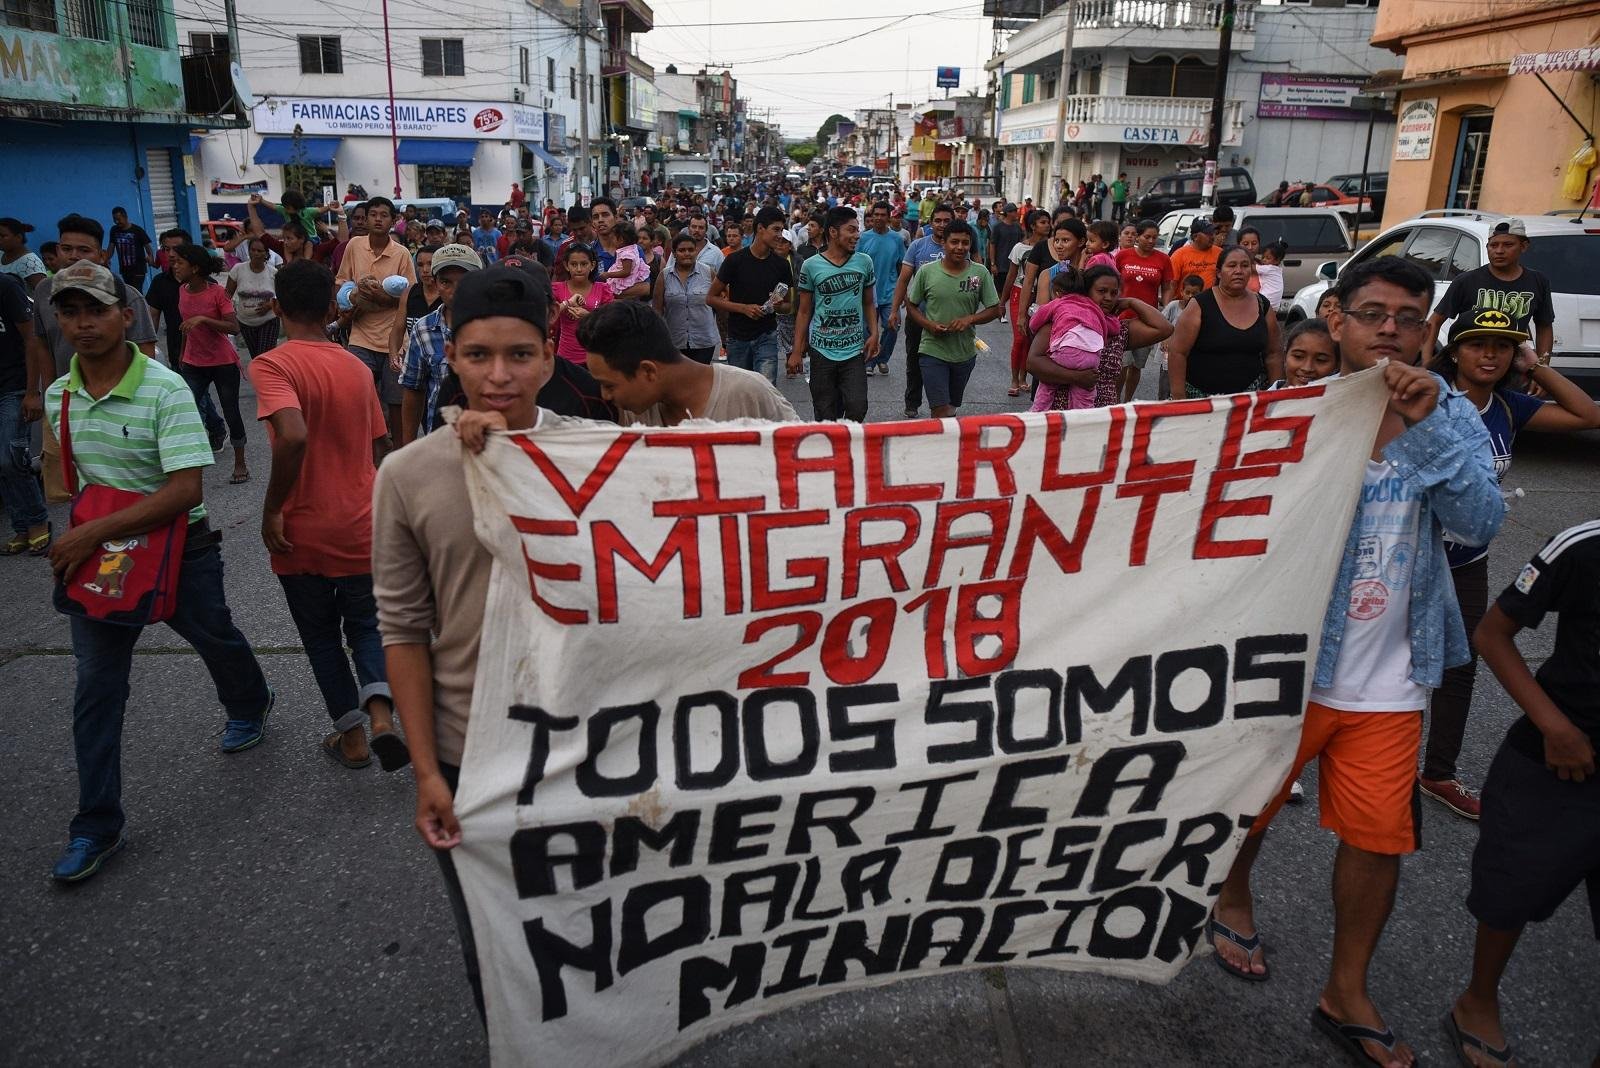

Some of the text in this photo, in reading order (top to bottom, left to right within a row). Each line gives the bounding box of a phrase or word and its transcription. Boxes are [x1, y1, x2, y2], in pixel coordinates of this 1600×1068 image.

[291, 103, 380, 120] FARMACIAS
[384, 105, 467, 123] SIMILARES
[365, 122, 384, 130] PERO
[386, 123, 402, 131] MS
[1123, 127, 1179, 142] CASETA
[1126, 157, 1159, 168] NOVIAS
[1476, 288, 1534, 319] JUST
[819, 312, 860, 329] VANS
[510, 386, 1326, 517] VIACRUCIS
[510, 463, 1282, 624] EMIGRANTE
[737, 578, 1021, 689] 2018
[508, 633, 1309, 805] TODOS SOMOS
[509, 740, 1188, 900] AMERICA
